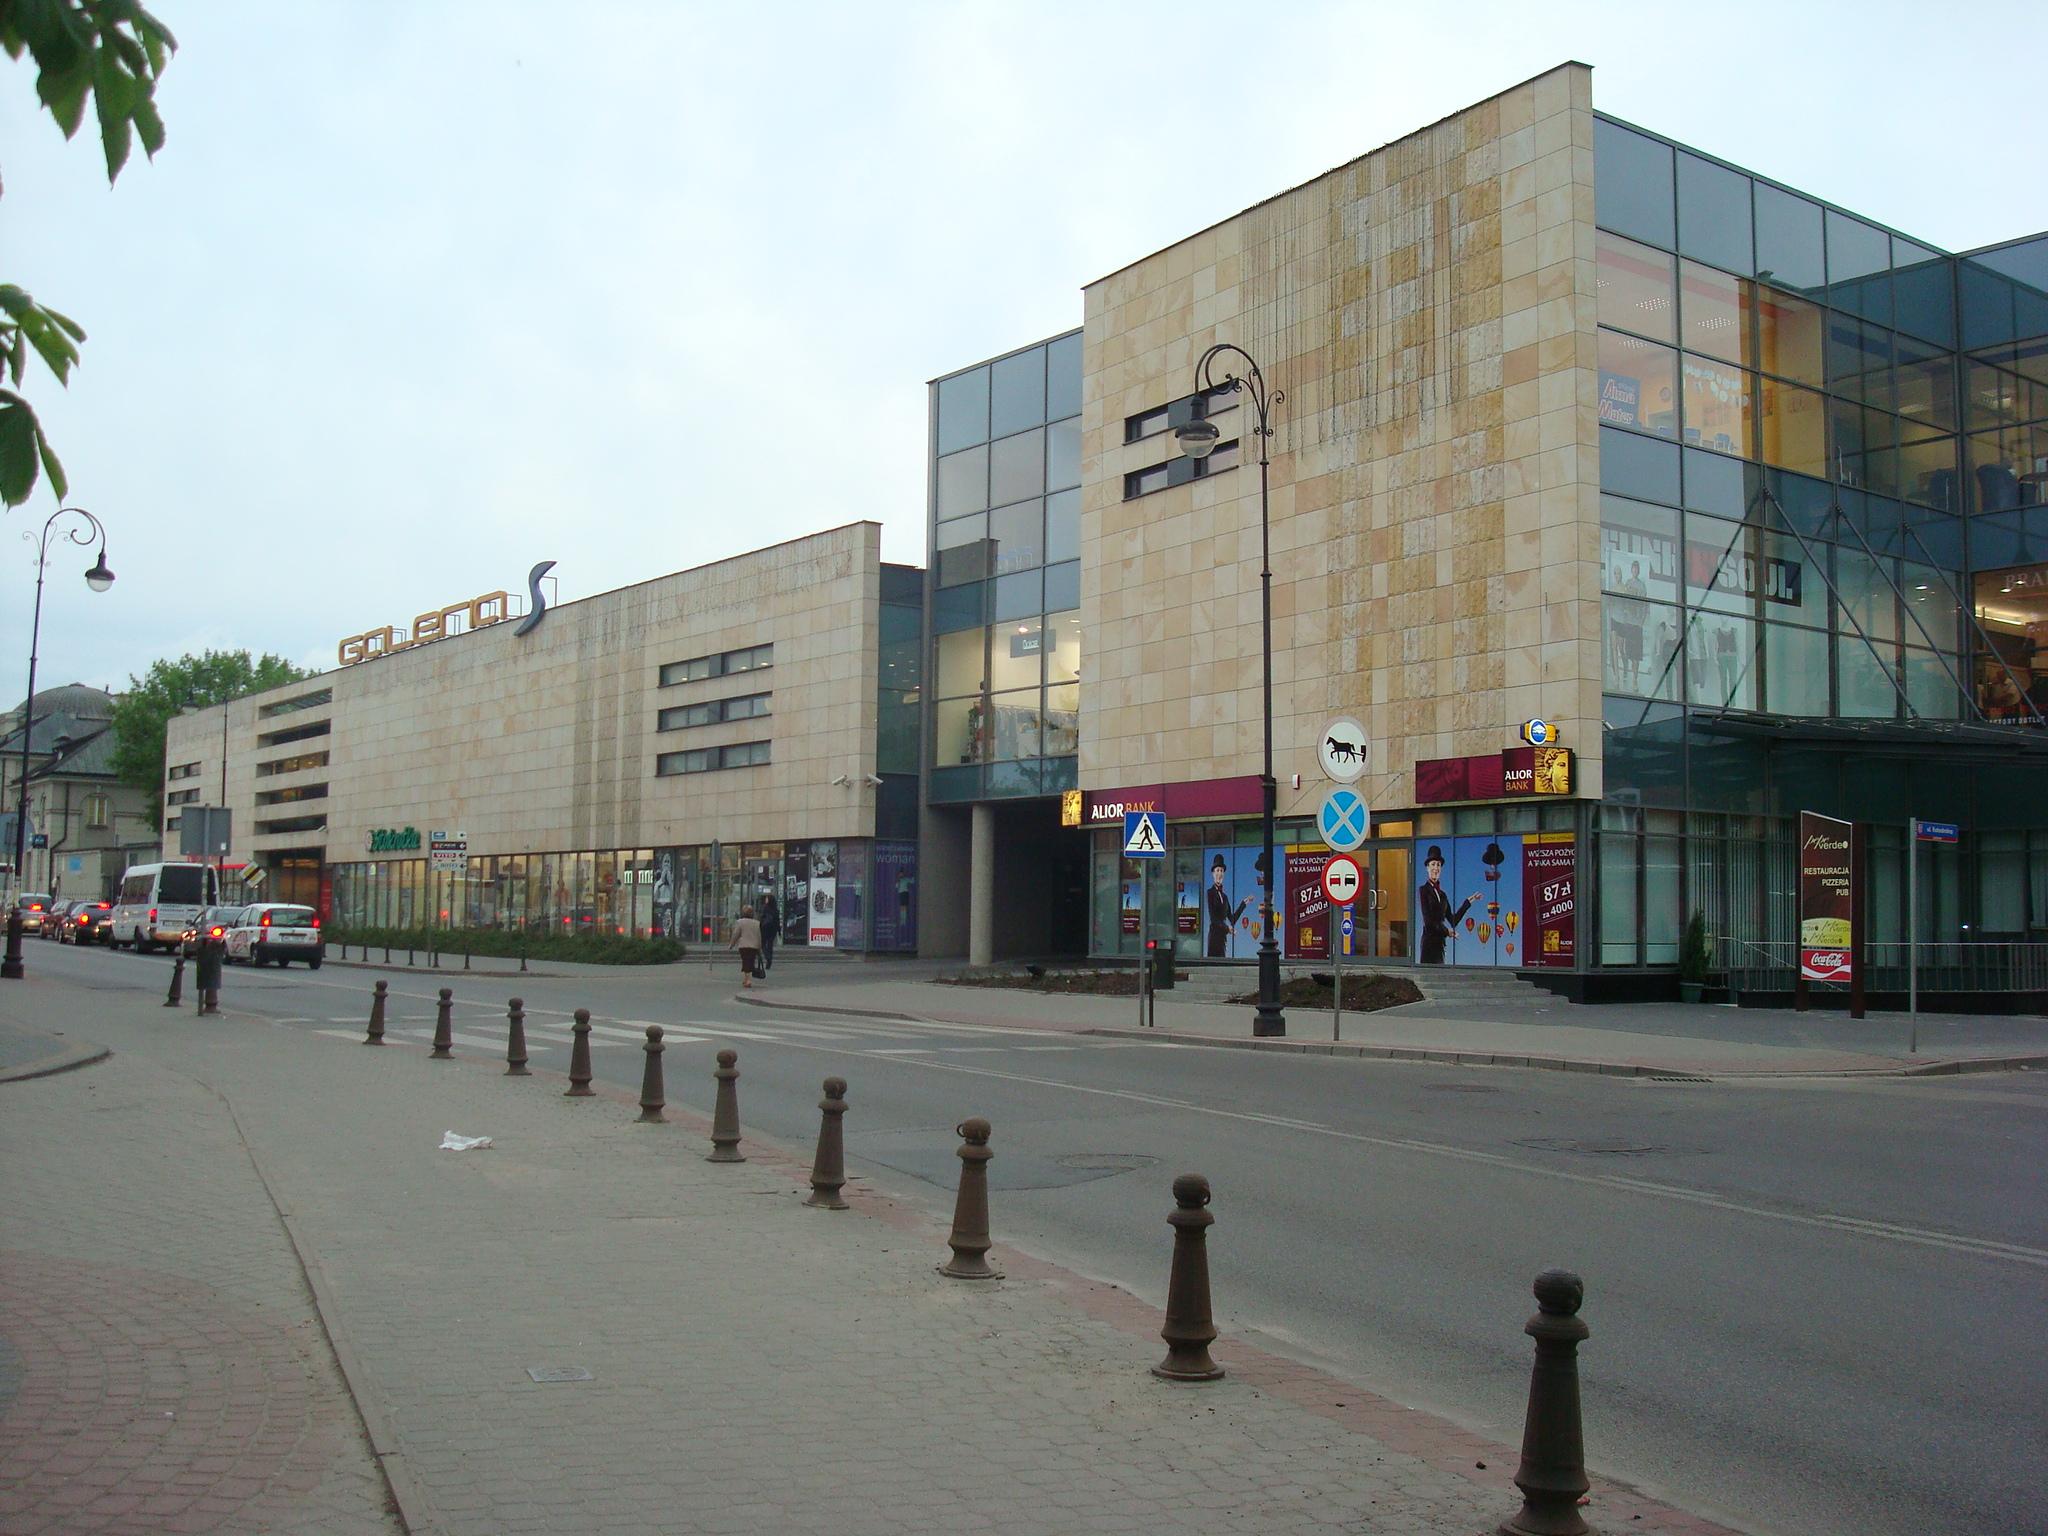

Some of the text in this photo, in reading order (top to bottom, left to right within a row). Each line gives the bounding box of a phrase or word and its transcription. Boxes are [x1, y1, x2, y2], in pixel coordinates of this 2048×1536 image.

[1505, 769, 1533, 781] ALIOR
[1506, 781, 1529, 791] BANK
[1091, 800, 1155, 820] ALIOR BANK
[1528, 849, 1553, 857] WYSZA
[876, 854, 915, 864] woman
[1289, 857, 1308, 865] WYSZA
[1804, 867, 1849, 876] RESTAURACJA
[1821, 878, 1849, 887] PIZZERIA
[1300, 885, 1321, 904] 87 zł
[1543, 881, 1571, 902] 87 zł
[1836, 888, 1849, 896] PUB
[1305, 901, 1323, 915] 4000
[1550, 899, 1573, 915] 4000
